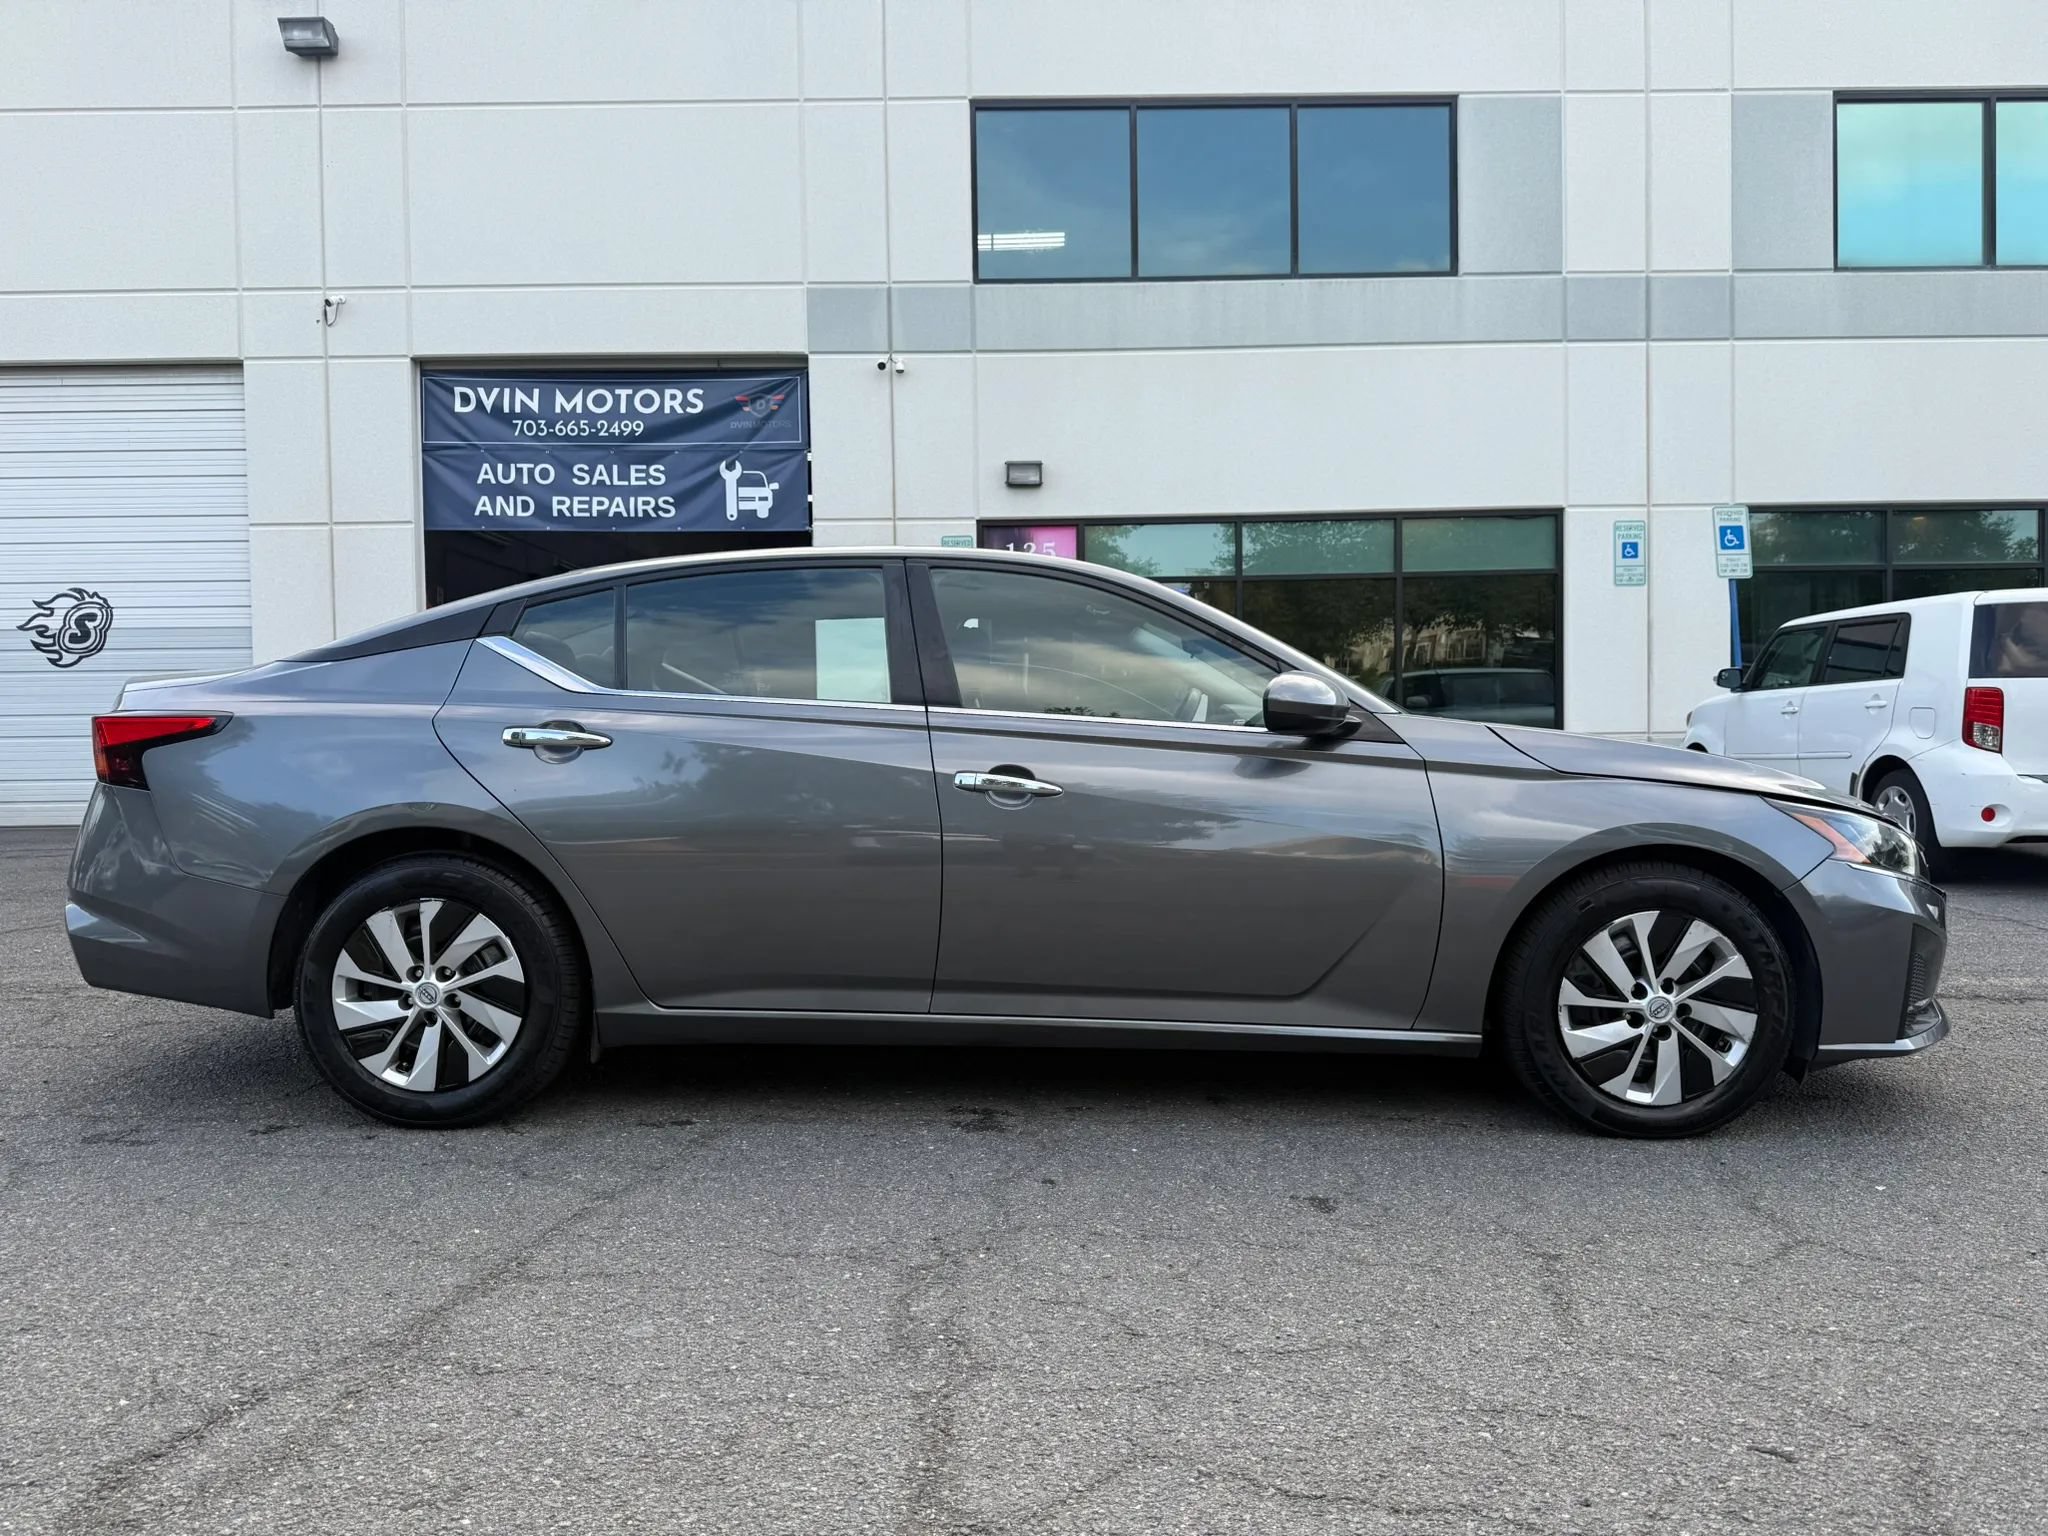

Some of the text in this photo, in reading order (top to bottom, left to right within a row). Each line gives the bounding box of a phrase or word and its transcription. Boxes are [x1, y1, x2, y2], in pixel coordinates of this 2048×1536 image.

[453, 386, 704, 415] DVIN MOTORS
[512, 419, 644, 437] 703-665-2499
[476, 463, 666, 486] AUTO SALES
[474, 495, 676, 518] AND REPAIRS
